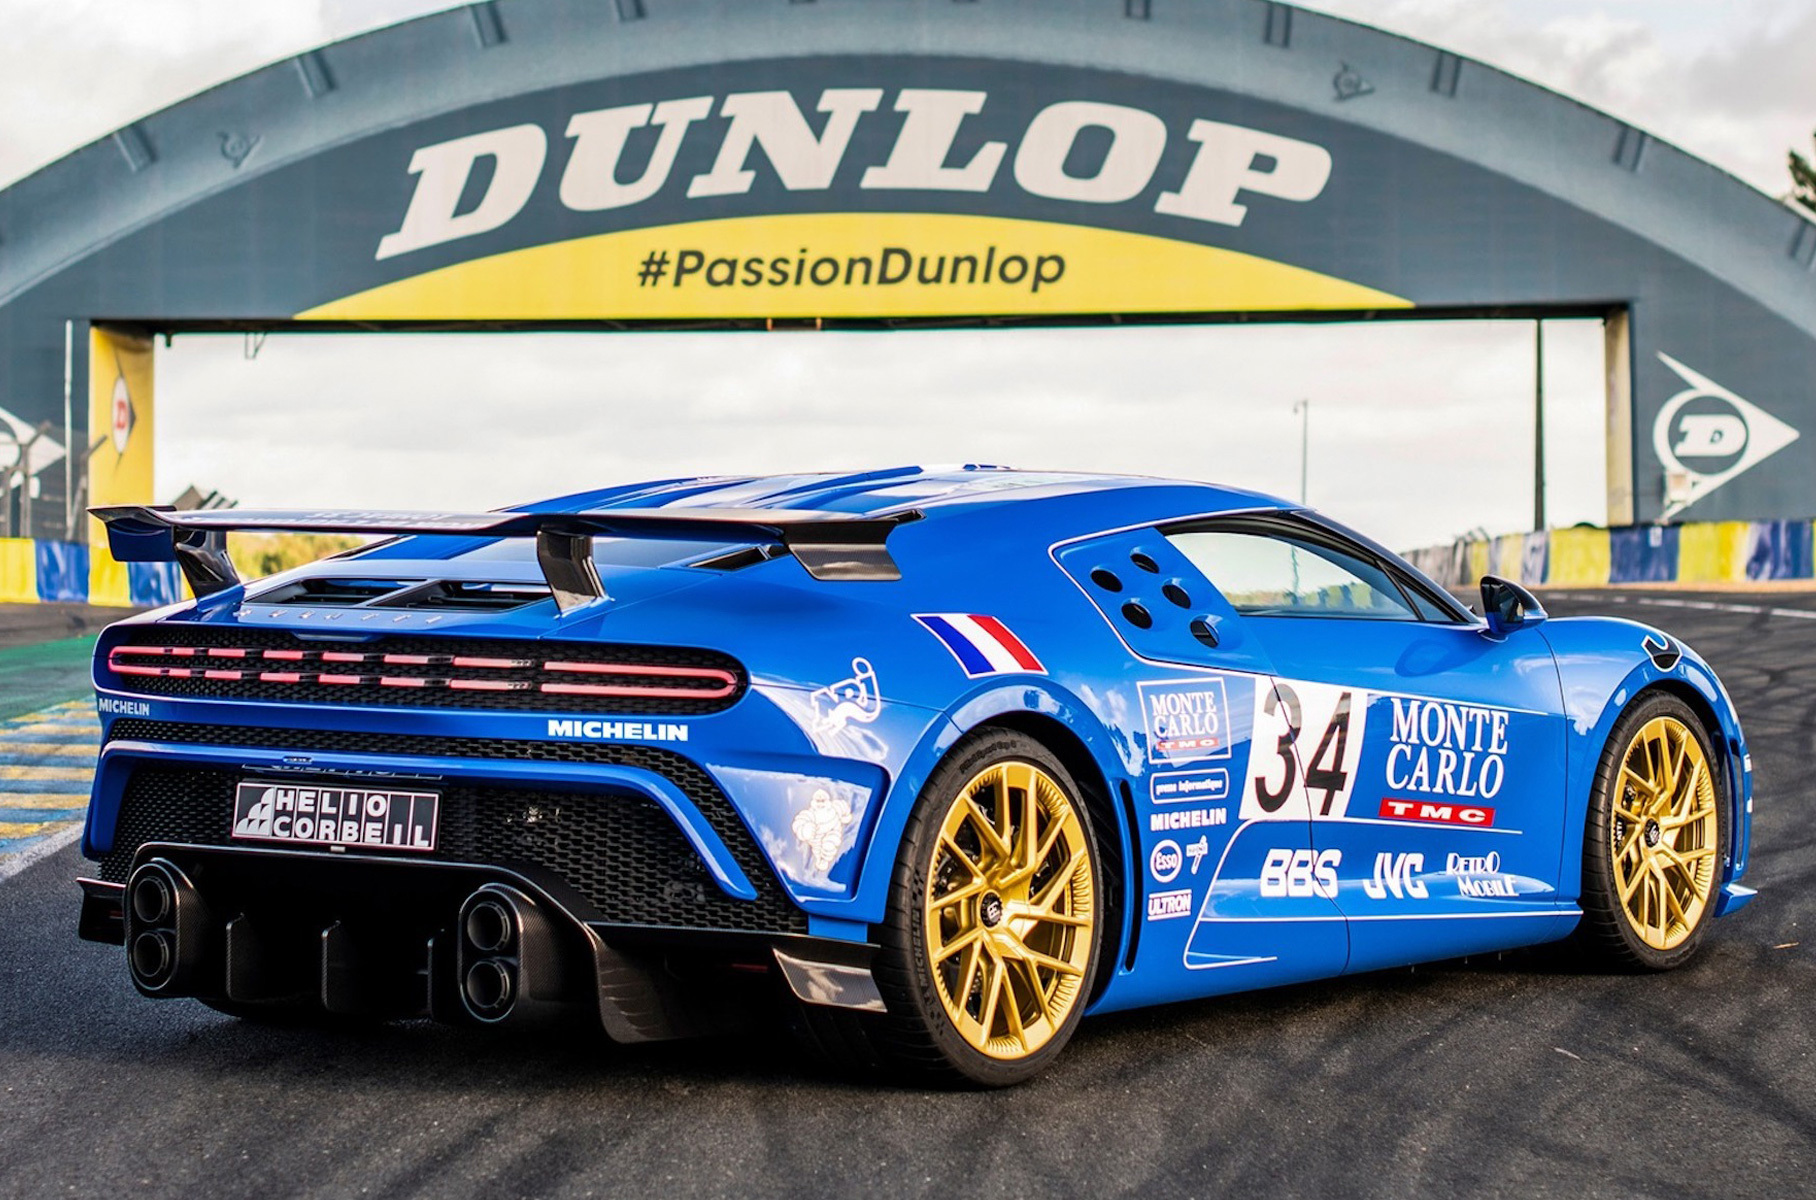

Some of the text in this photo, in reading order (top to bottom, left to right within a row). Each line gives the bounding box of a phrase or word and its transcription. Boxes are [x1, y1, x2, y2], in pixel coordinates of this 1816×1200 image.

[375, 88, 1332, 260] DUNLOP
[638, 246, 1066, 293] #PassionDunlop
[1674, 414, 1747, 457] D
[98, 698, 150, 716] MICHELIN
[1150, 691, 1217, 716] MONTE
[548, 719, 689, 742] MICHELIN
[1154, 713, 1219, 738] CARLO
[1390, 698, 1509, 754] MONTE
[1254, 683, 1352, 816] 34
[1386, 743, 1505, 799] CARLO
[275, 789, 387, 818] HELIO
[1150, 807, 1228, 832] MICHELIN
[1388, 801, 1487, 823] TMC
[273, 816, 429, 848] CORBEIL
[1260, 848, 1342, 898] BBS
[1362, 852, 1429, 899] JVC
[1148, 892, 1192, 917] ULTRON
[911, 908, 929, 988] MICHELIN
